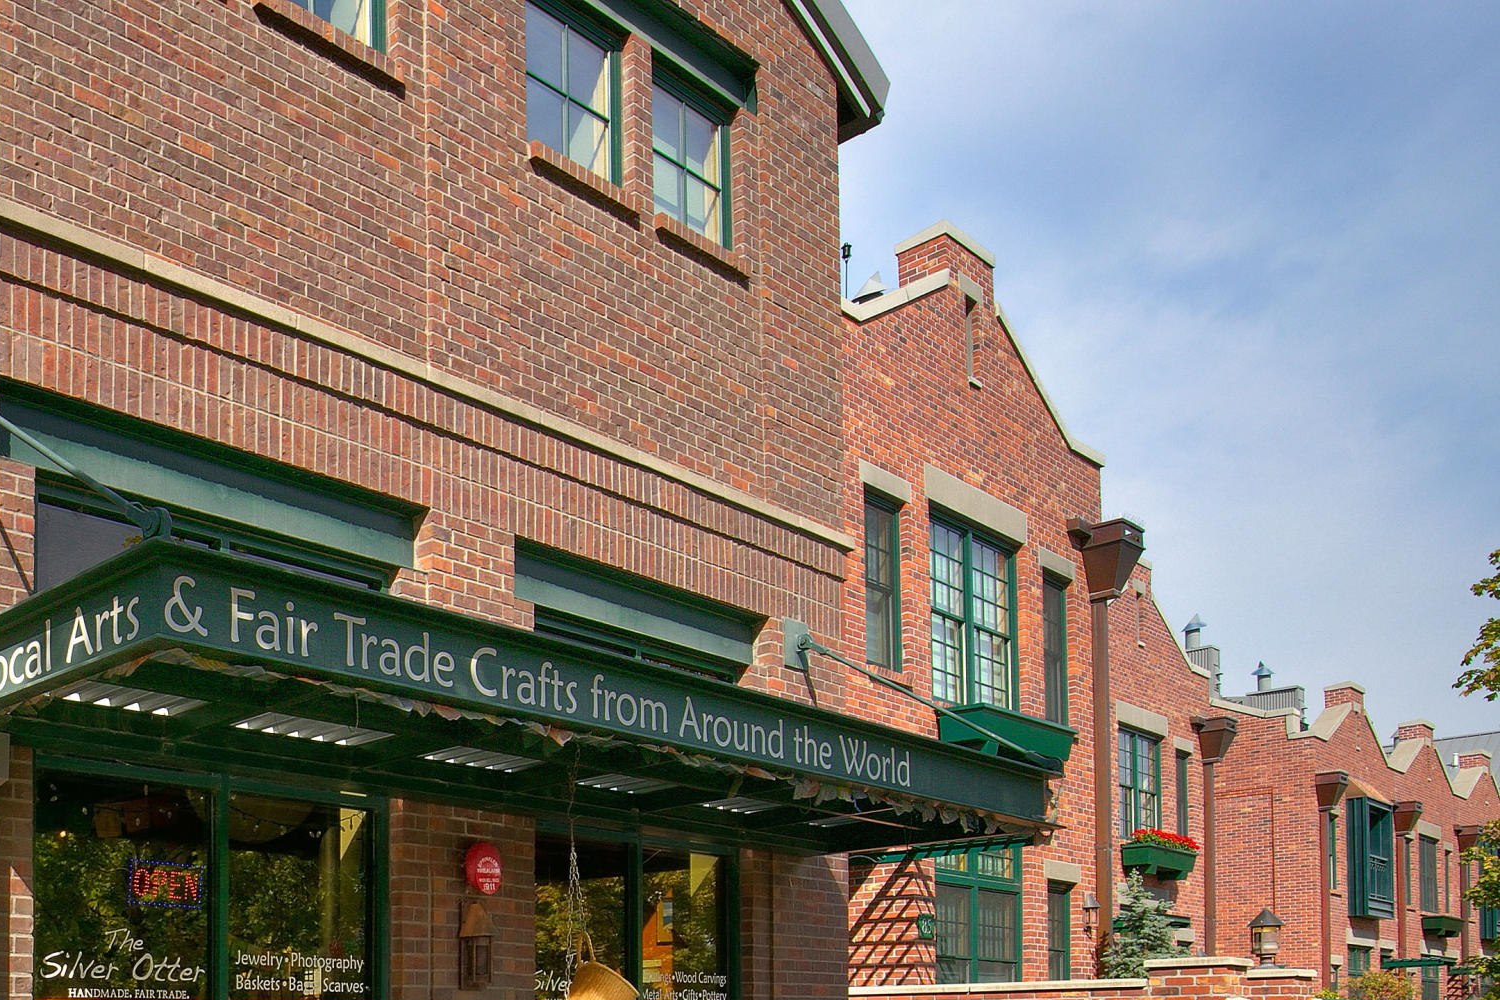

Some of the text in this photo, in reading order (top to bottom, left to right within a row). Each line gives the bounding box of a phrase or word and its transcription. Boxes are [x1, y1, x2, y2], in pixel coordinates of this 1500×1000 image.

[65, 595, 140, 664] Arts
[164, 575, 209, 637] &
[230, 586, 319, 657] Fair
[333, 611, 456, 687] Trade
[470, 647, 578, 714] Crafts
[590, 674, 669, 733] from
[679, 696, 785, 760] Around
[793, 725, 833, 770] the
[838, 735, 911, 787] World
[133, 868, 199, 901] OPEN
[104, 928, 145, 951] The
[40, 950, 206, 983] Silver Otter
[235, 949, 364, 973] Jewelry Photography
[235, 974, 281, 991] Baskets
[323, 977, 364, 993] Scarves
[675, 971, 697, 984] Wood
[698, 971, 727, 988] Carvings
[68, 987, 190, 1000] HANDMADE. FAIR TRADE.
[664, 989, 678, 1000] Arts
[682, 988, 698, 1000] Gifts
